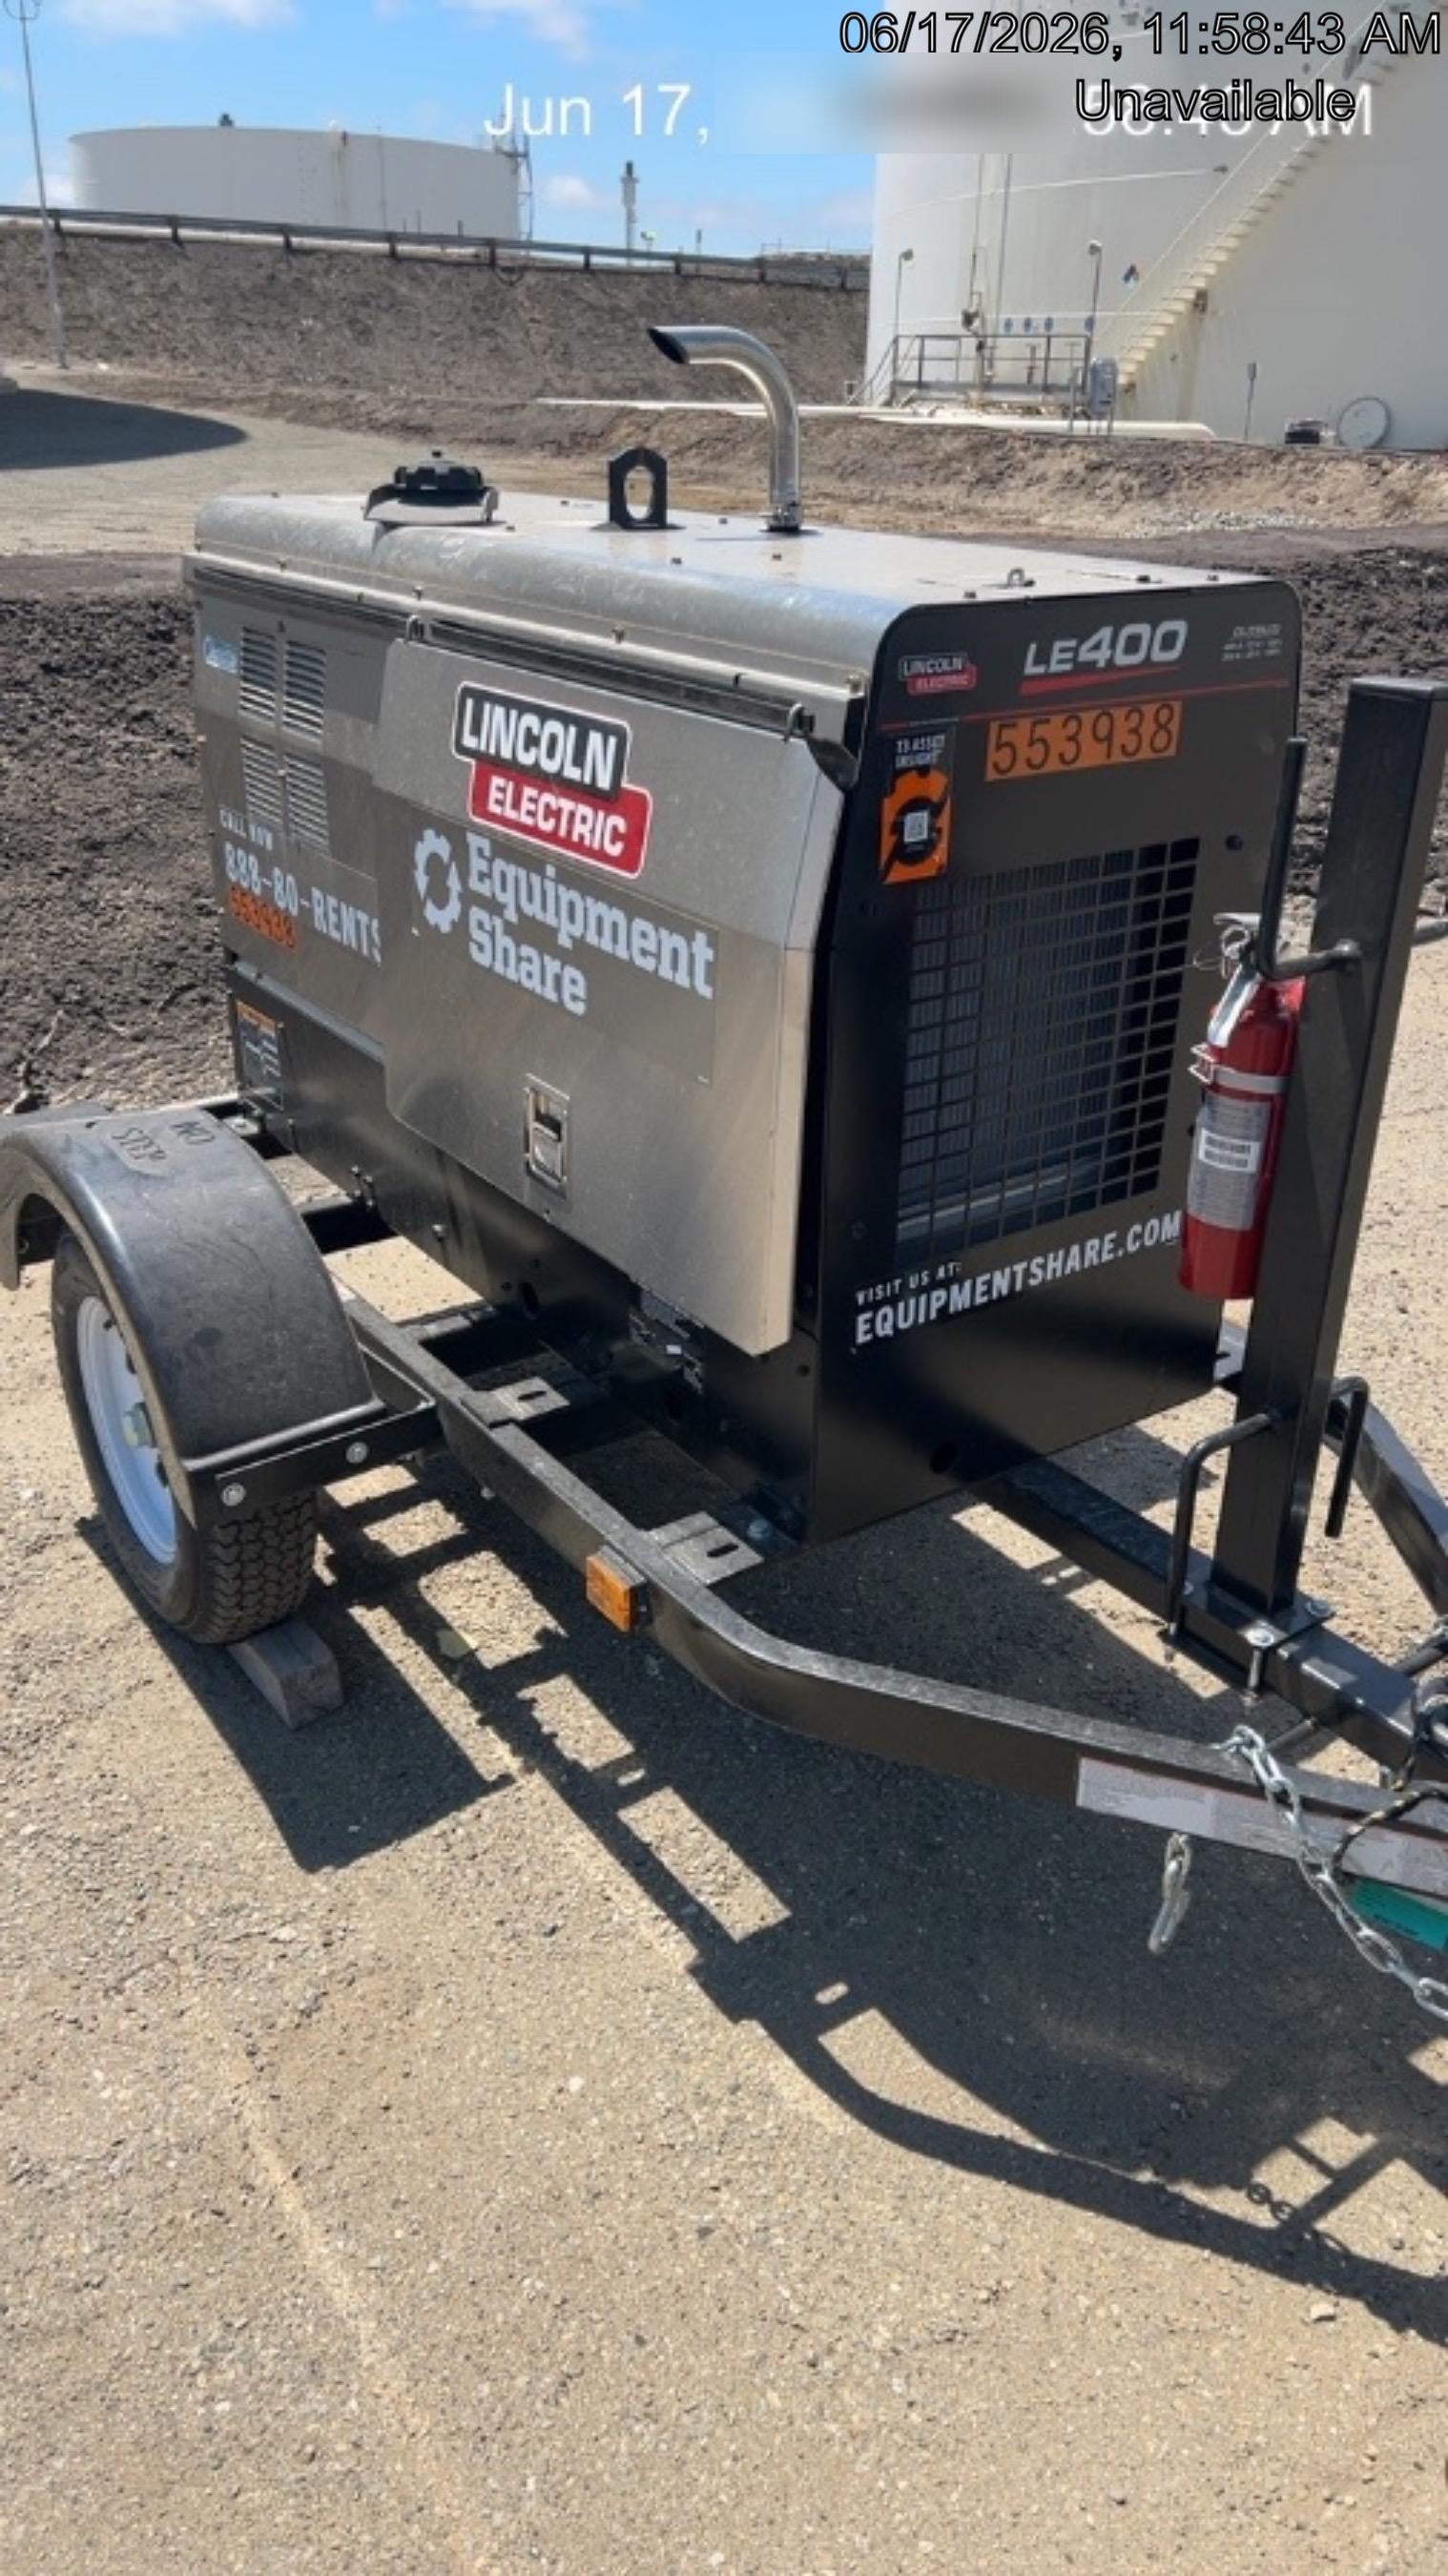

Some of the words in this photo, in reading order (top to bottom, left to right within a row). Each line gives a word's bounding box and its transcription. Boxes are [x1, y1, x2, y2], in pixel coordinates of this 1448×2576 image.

[903, 656, 963, 677] LINCOLN
[915, 674, 969, 690] ELECTRIC
[1023, 619, 1189, 676] LE400
[461, 696, 618, 792] LINCOLN
[992, 702, 1175, 776] 553938
[219, 808, 247, 840] CALL
[486, 775, 628, 858] ELECTRIC
[466, 831, 714, 1001] Equipment
[467, 905, 589, 1017] Share
[855, 1210, 1183, 1346] EQUIPMENTSHARE.COM
[855, 1278, 902, 1307] VISIT
[908, 1269, 930, 1290] US
